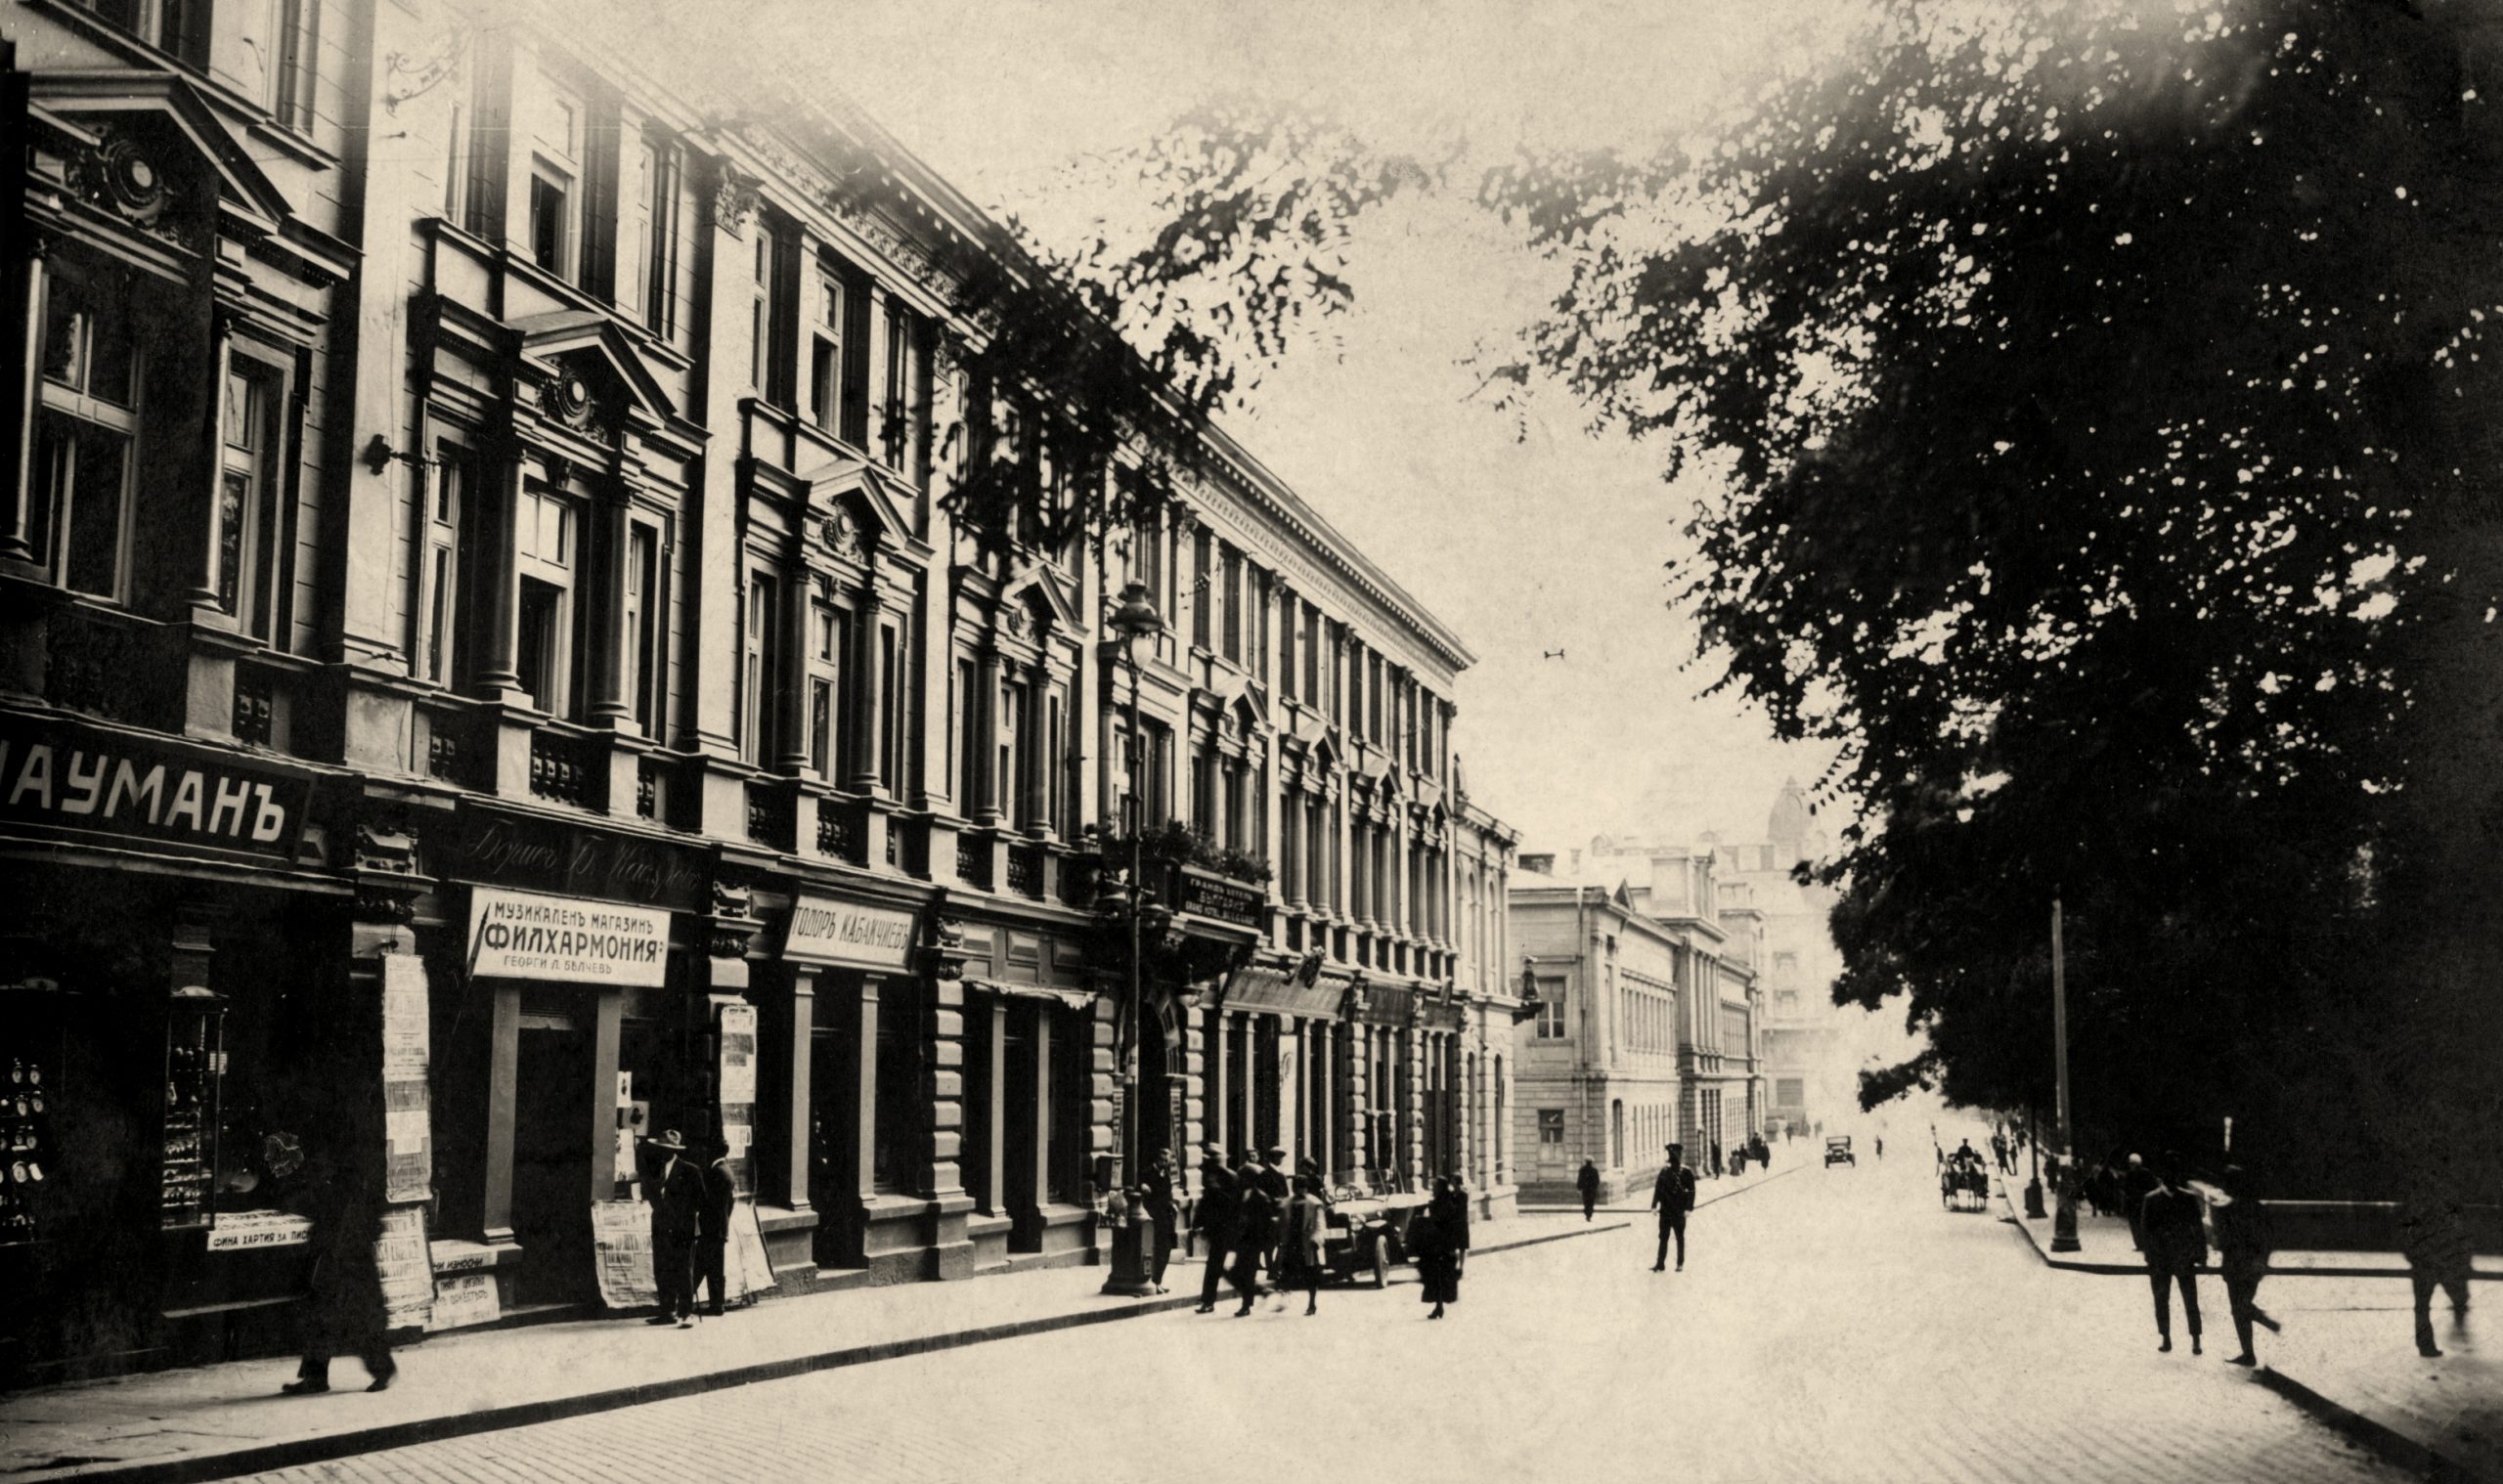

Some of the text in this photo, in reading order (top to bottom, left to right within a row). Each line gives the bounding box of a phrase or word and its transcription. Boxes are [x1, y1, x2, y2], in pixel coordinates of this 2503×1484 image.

[495, 901, 653, 935] МУЗИКАЛЕНЪ МАГАЗИНЪ
[792, 906, 908, 950] ТОДОРЪ КАБАКЧИЕВЪ
[504, 955, 548, 969] ГЕОРГИ
[213, 1230, 308, 1247] ФИНА ХАРТИЯ ЗА ПИС
[432, 1261, 445, 1270] НИ
